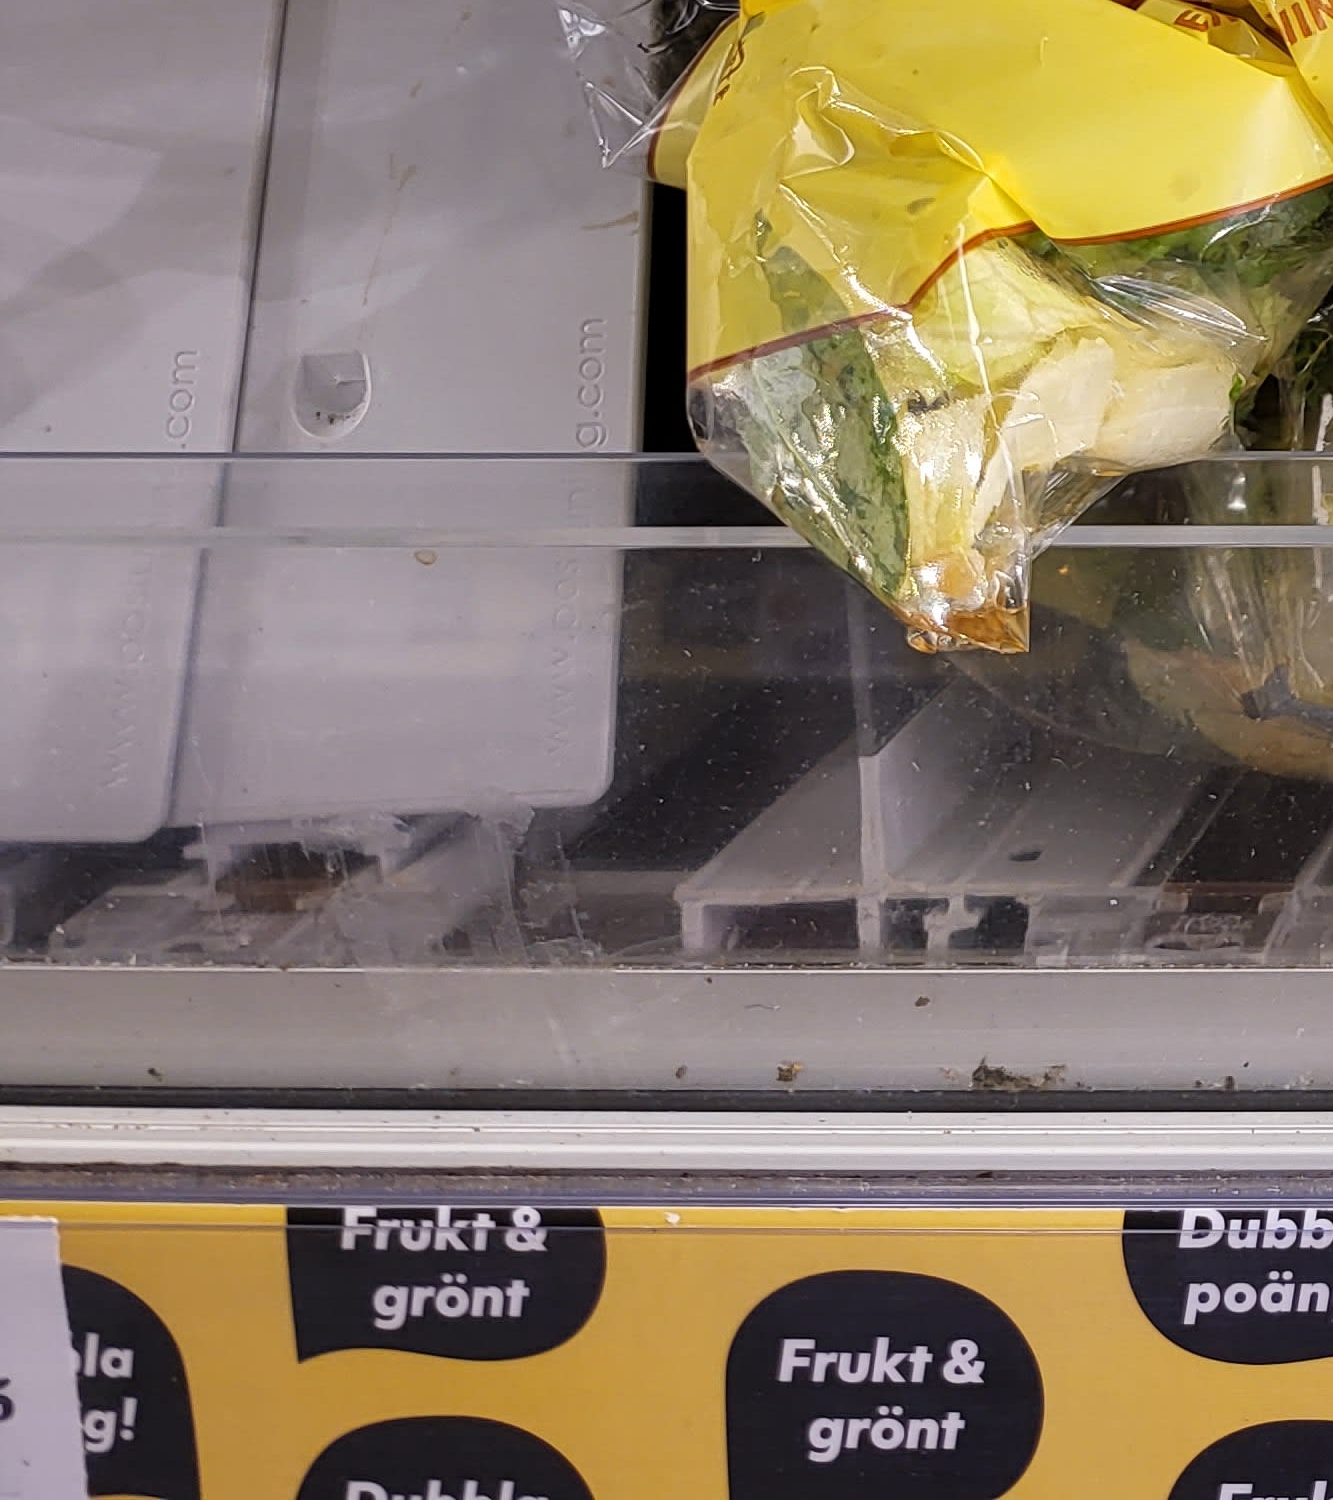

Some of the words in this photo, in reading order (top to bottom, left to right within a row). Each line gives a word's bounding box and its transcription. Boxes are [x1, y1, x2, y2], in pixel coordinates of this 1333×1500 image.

[339, 1207, 494, 1252] Frukt
[505, 1207, 548, 1252] &
[372, 1274, 530, 1331] grönt
[777, 1336, 932, 1384] Frukt
[942, 1338, 986, 1383] &
[807, 1407, 966, 1463] grönt
